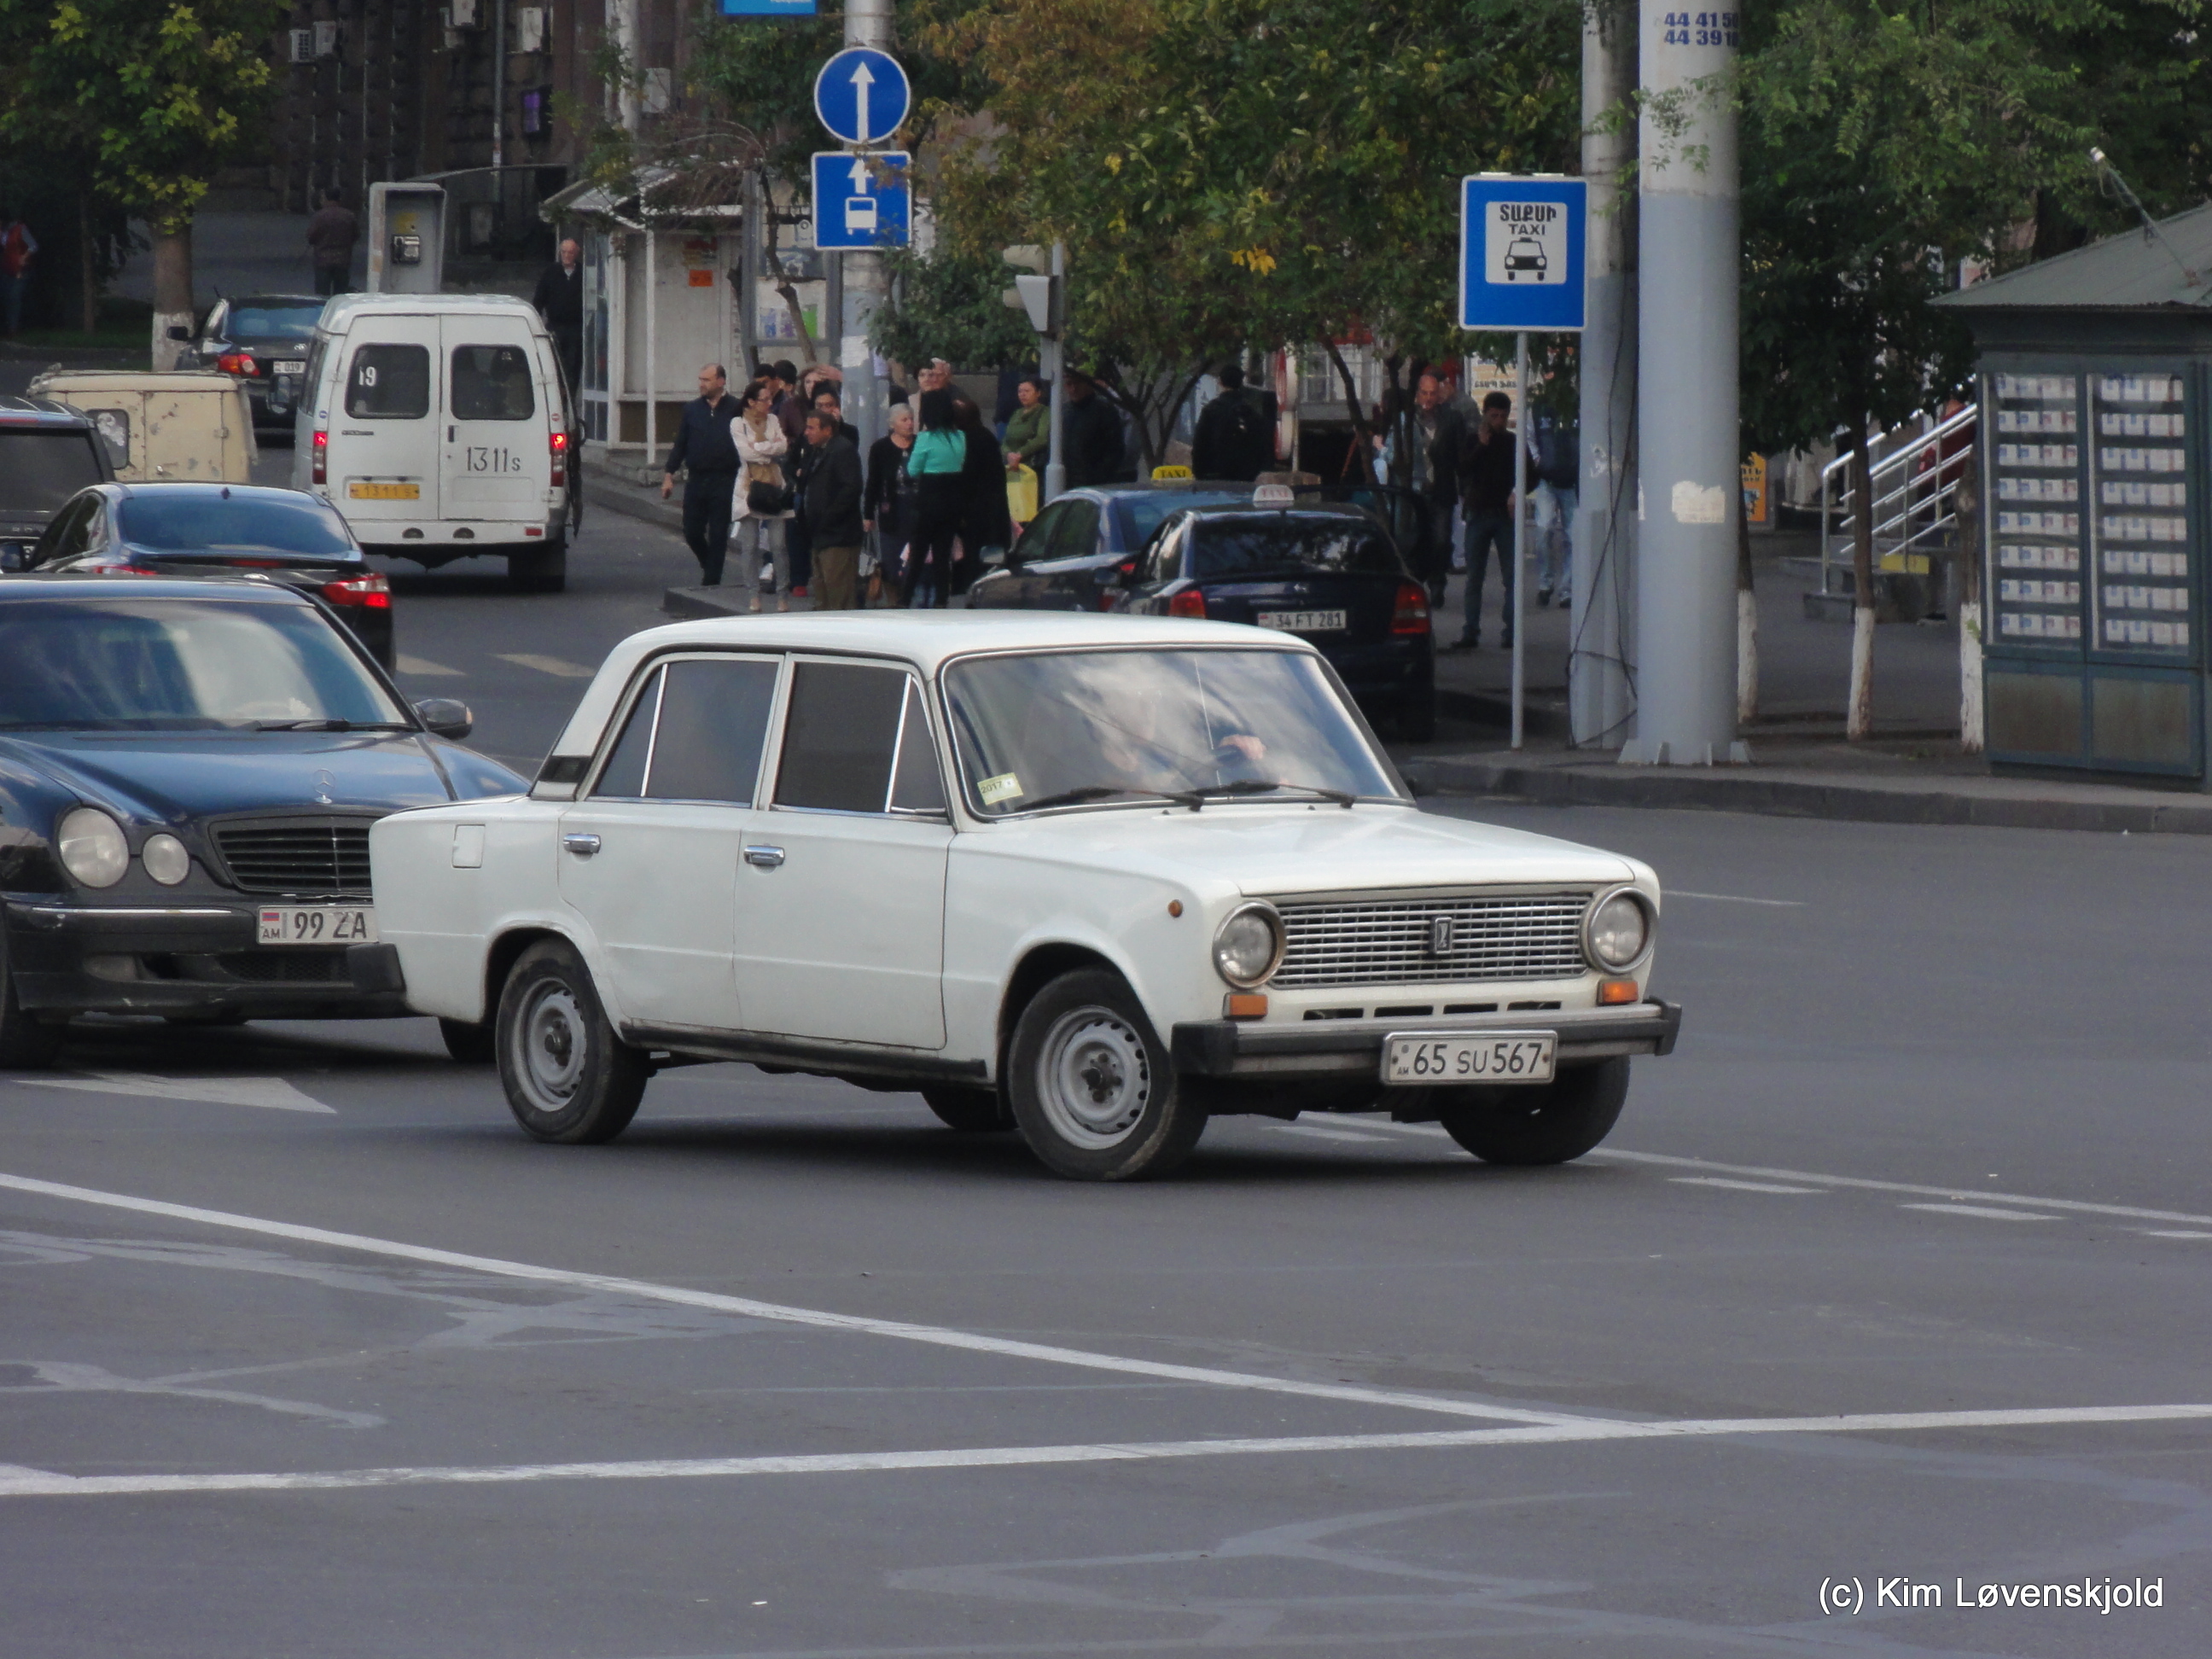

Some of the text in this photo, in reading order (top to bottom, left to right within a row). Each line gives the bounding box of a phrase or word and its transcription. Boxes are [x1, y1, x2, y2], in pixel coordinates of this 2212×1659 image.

[1664, 12, 1689, 27] 44
[1696, 12, 1717, 27] 41
[1664, 29, 1689, 44] 44
[1697, 30, 1722, 45] 39
[1509, 224, 1545, 235] TAXI
[359, 366, 376, 387] 19
[1161, 469, 1186, 478] TAXI
[1261, 488, 1289, 498] TAXI
[981, 781, 1003, 794] 2017
[262, 911, 367, 939] AM 99 ZA
[1397, 1042, 1542, 1075] AM 65 SU 567
